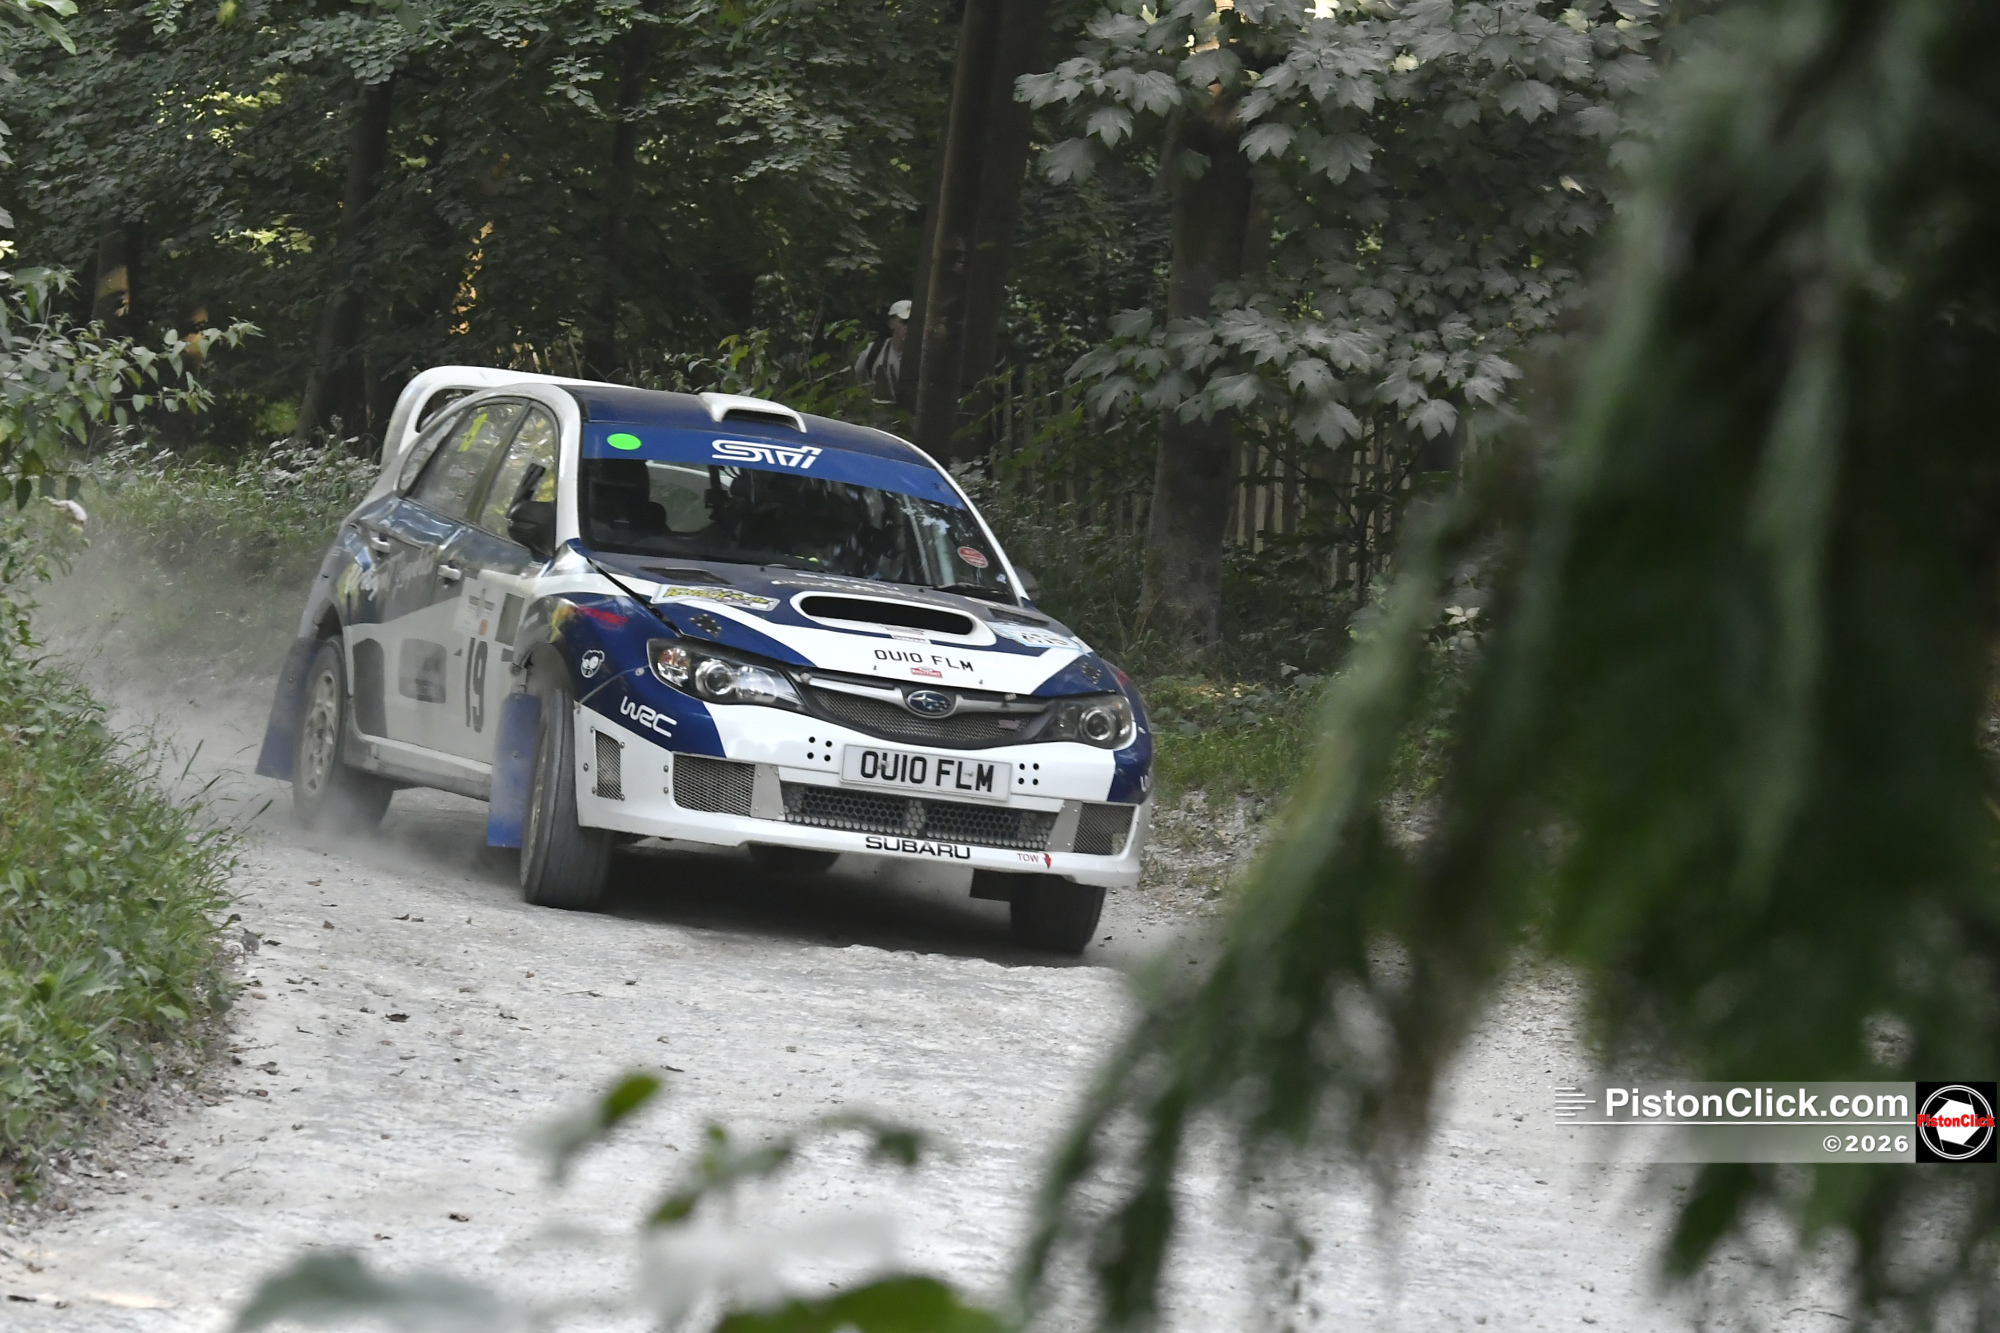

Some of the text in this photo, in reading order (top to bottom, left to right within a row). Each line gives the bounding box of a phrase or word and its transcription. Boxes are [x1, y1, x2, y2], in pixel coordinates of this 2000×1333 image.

[874, 650, 923, 663] OU10
[931, 655, 974, 672] FLM
[465, 637, 488, 733] 19
[620, 696, 677, 737] WRC
[861, 750, 994, 792] OU10 FLM
[865, 836, 971, 859] SUBARU
[1017, 853, 1039, 863] TOW
